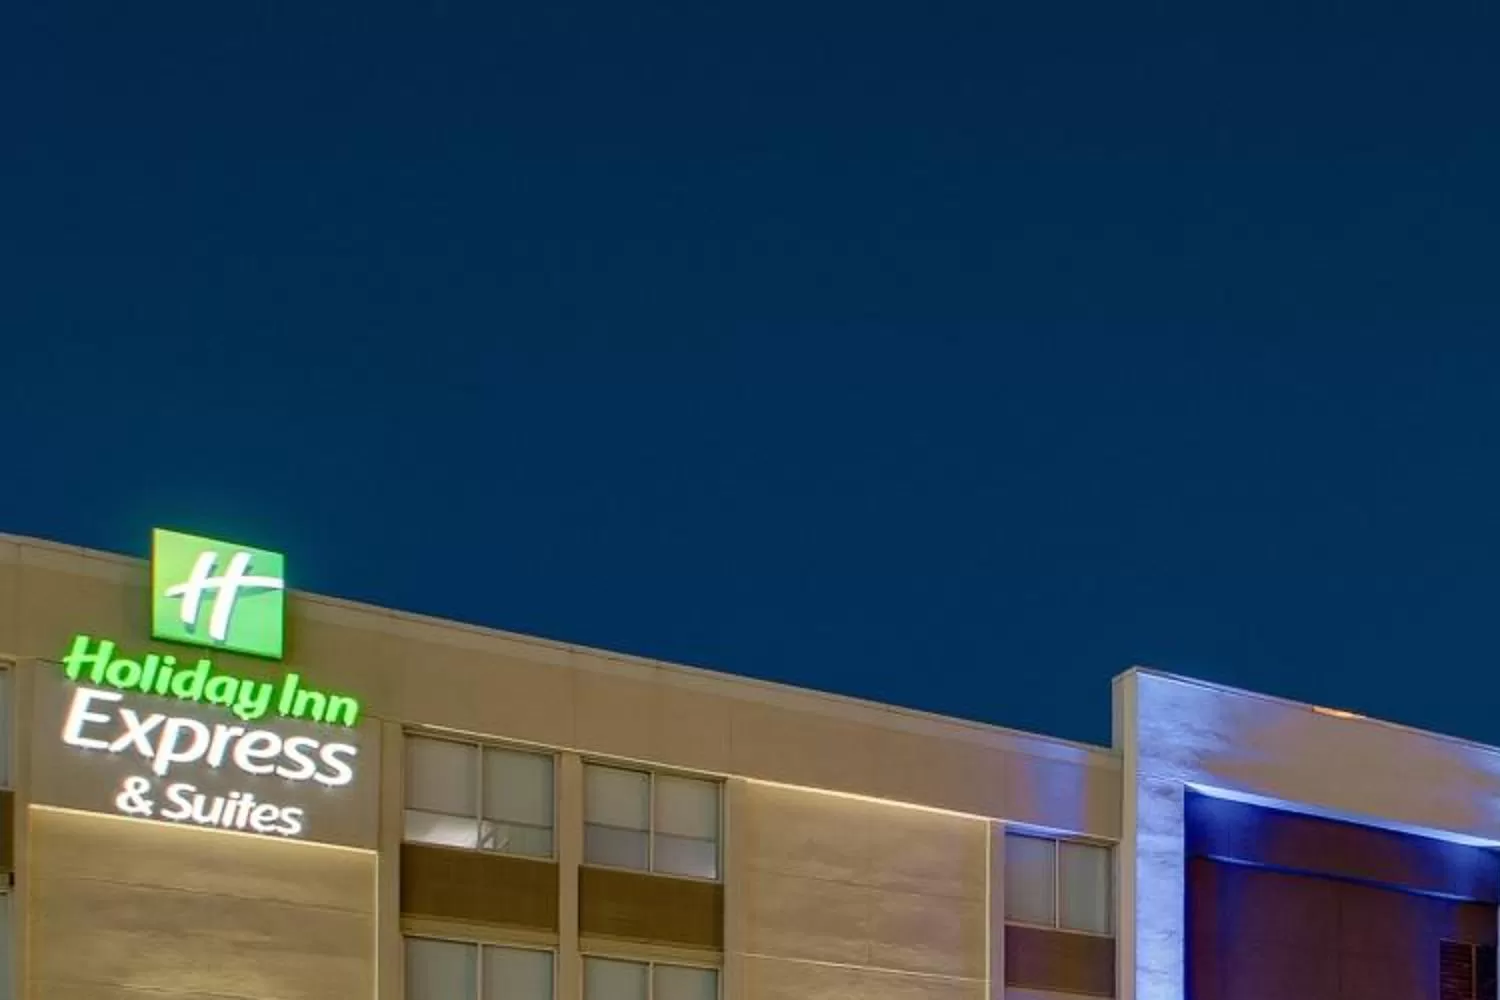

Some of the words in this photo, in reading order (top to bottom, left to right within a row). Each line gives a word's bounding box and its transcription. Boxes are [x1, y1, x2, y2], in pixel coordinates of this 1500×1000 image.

[164, 551, 284, 641] H
[63, 635, 272, 720] Holiday
[279, 673, 360, 726] Inn
[62, 687, 357, 786] Express
[115, 776, 154, 816] &
[160, 783, 304, 835] Suites
